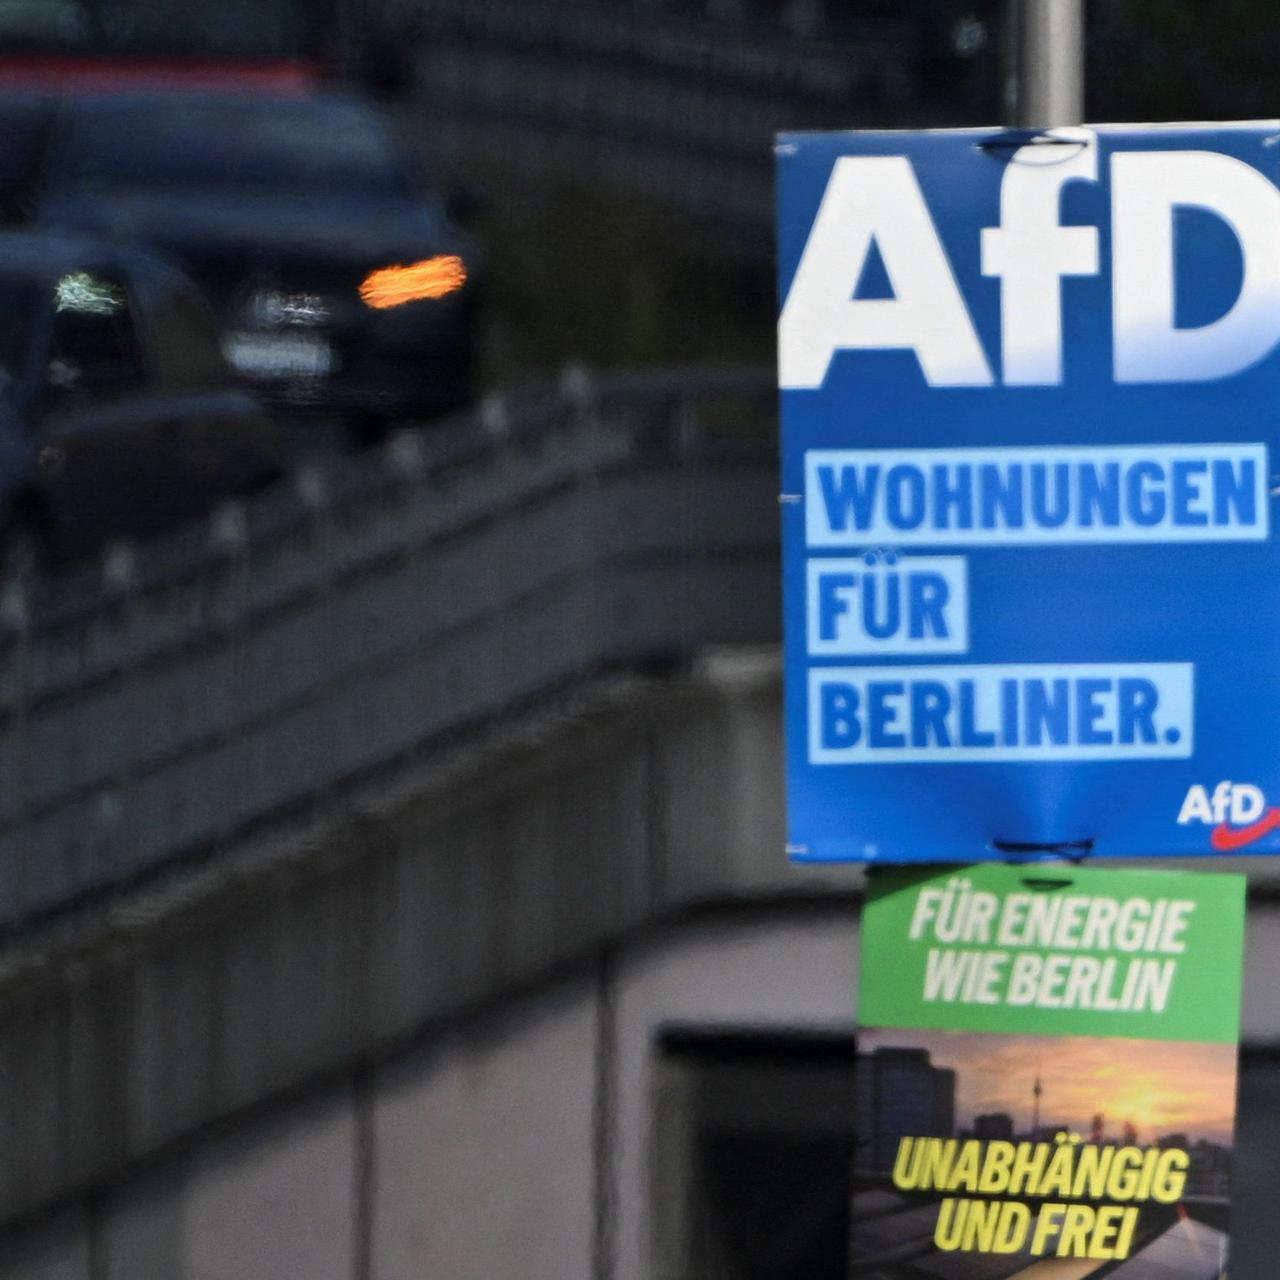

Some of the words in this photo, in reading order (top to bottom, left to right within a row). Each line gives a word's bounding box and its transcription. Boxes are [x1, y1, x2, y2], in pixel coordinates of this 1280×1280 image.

[816, 457, 1259, 532] WOHNUNGEN
[817, 549, 950, 641] FÜR
[820, 676, 1182, 751] BERLINER.
[1177, 782, 1265, 825] AfD
[909, 877, 998, 942] FÜR
[1000, 892, 1196, 953] ENERGIE
[923, 949, 1009, 1005] WIE
[1006, 952, 1177, 1013] BERLIN
[892, 1131, 1190, 1203] UNABHÄNGIG
[933, 1199, 1032, 1254] UND
[1030, 1204, 1140, 1260] FREI
